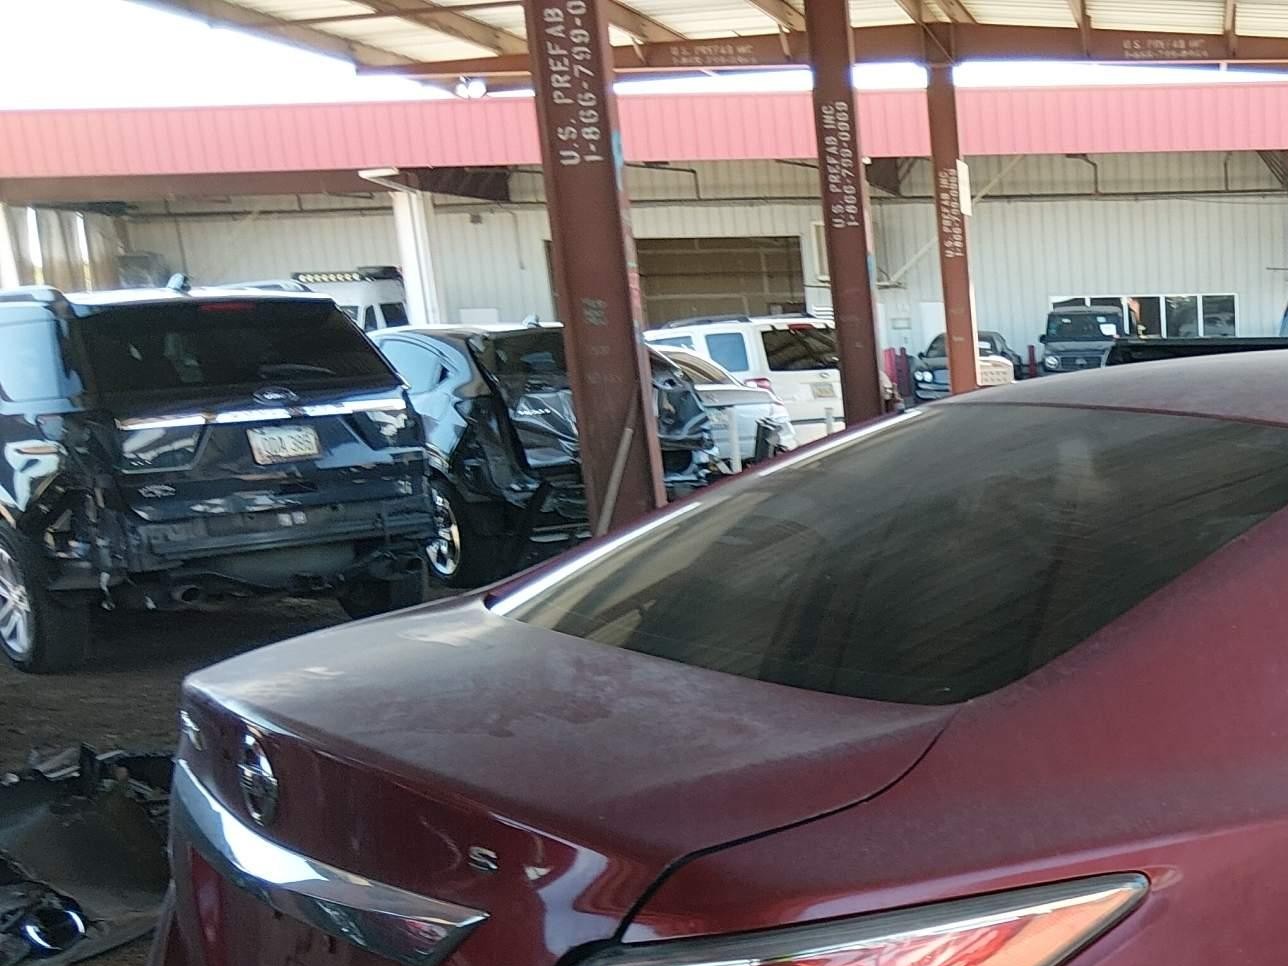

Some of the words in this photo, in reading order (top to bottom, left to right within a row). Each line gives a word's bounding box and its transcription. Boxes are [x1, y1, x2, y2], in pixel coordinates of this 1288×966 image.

[543, 7, 574, 105] PREFAB
[566, 0, 604, 161] 1-866-799-0
[556, 118, 581, 166] U.S.
[824, 136, 842, 193] PREFAB
[831, 200, 846, 228] U.S.
[940, 192, 953, 233] PREFAB
[468, 846, 498, 871] S
